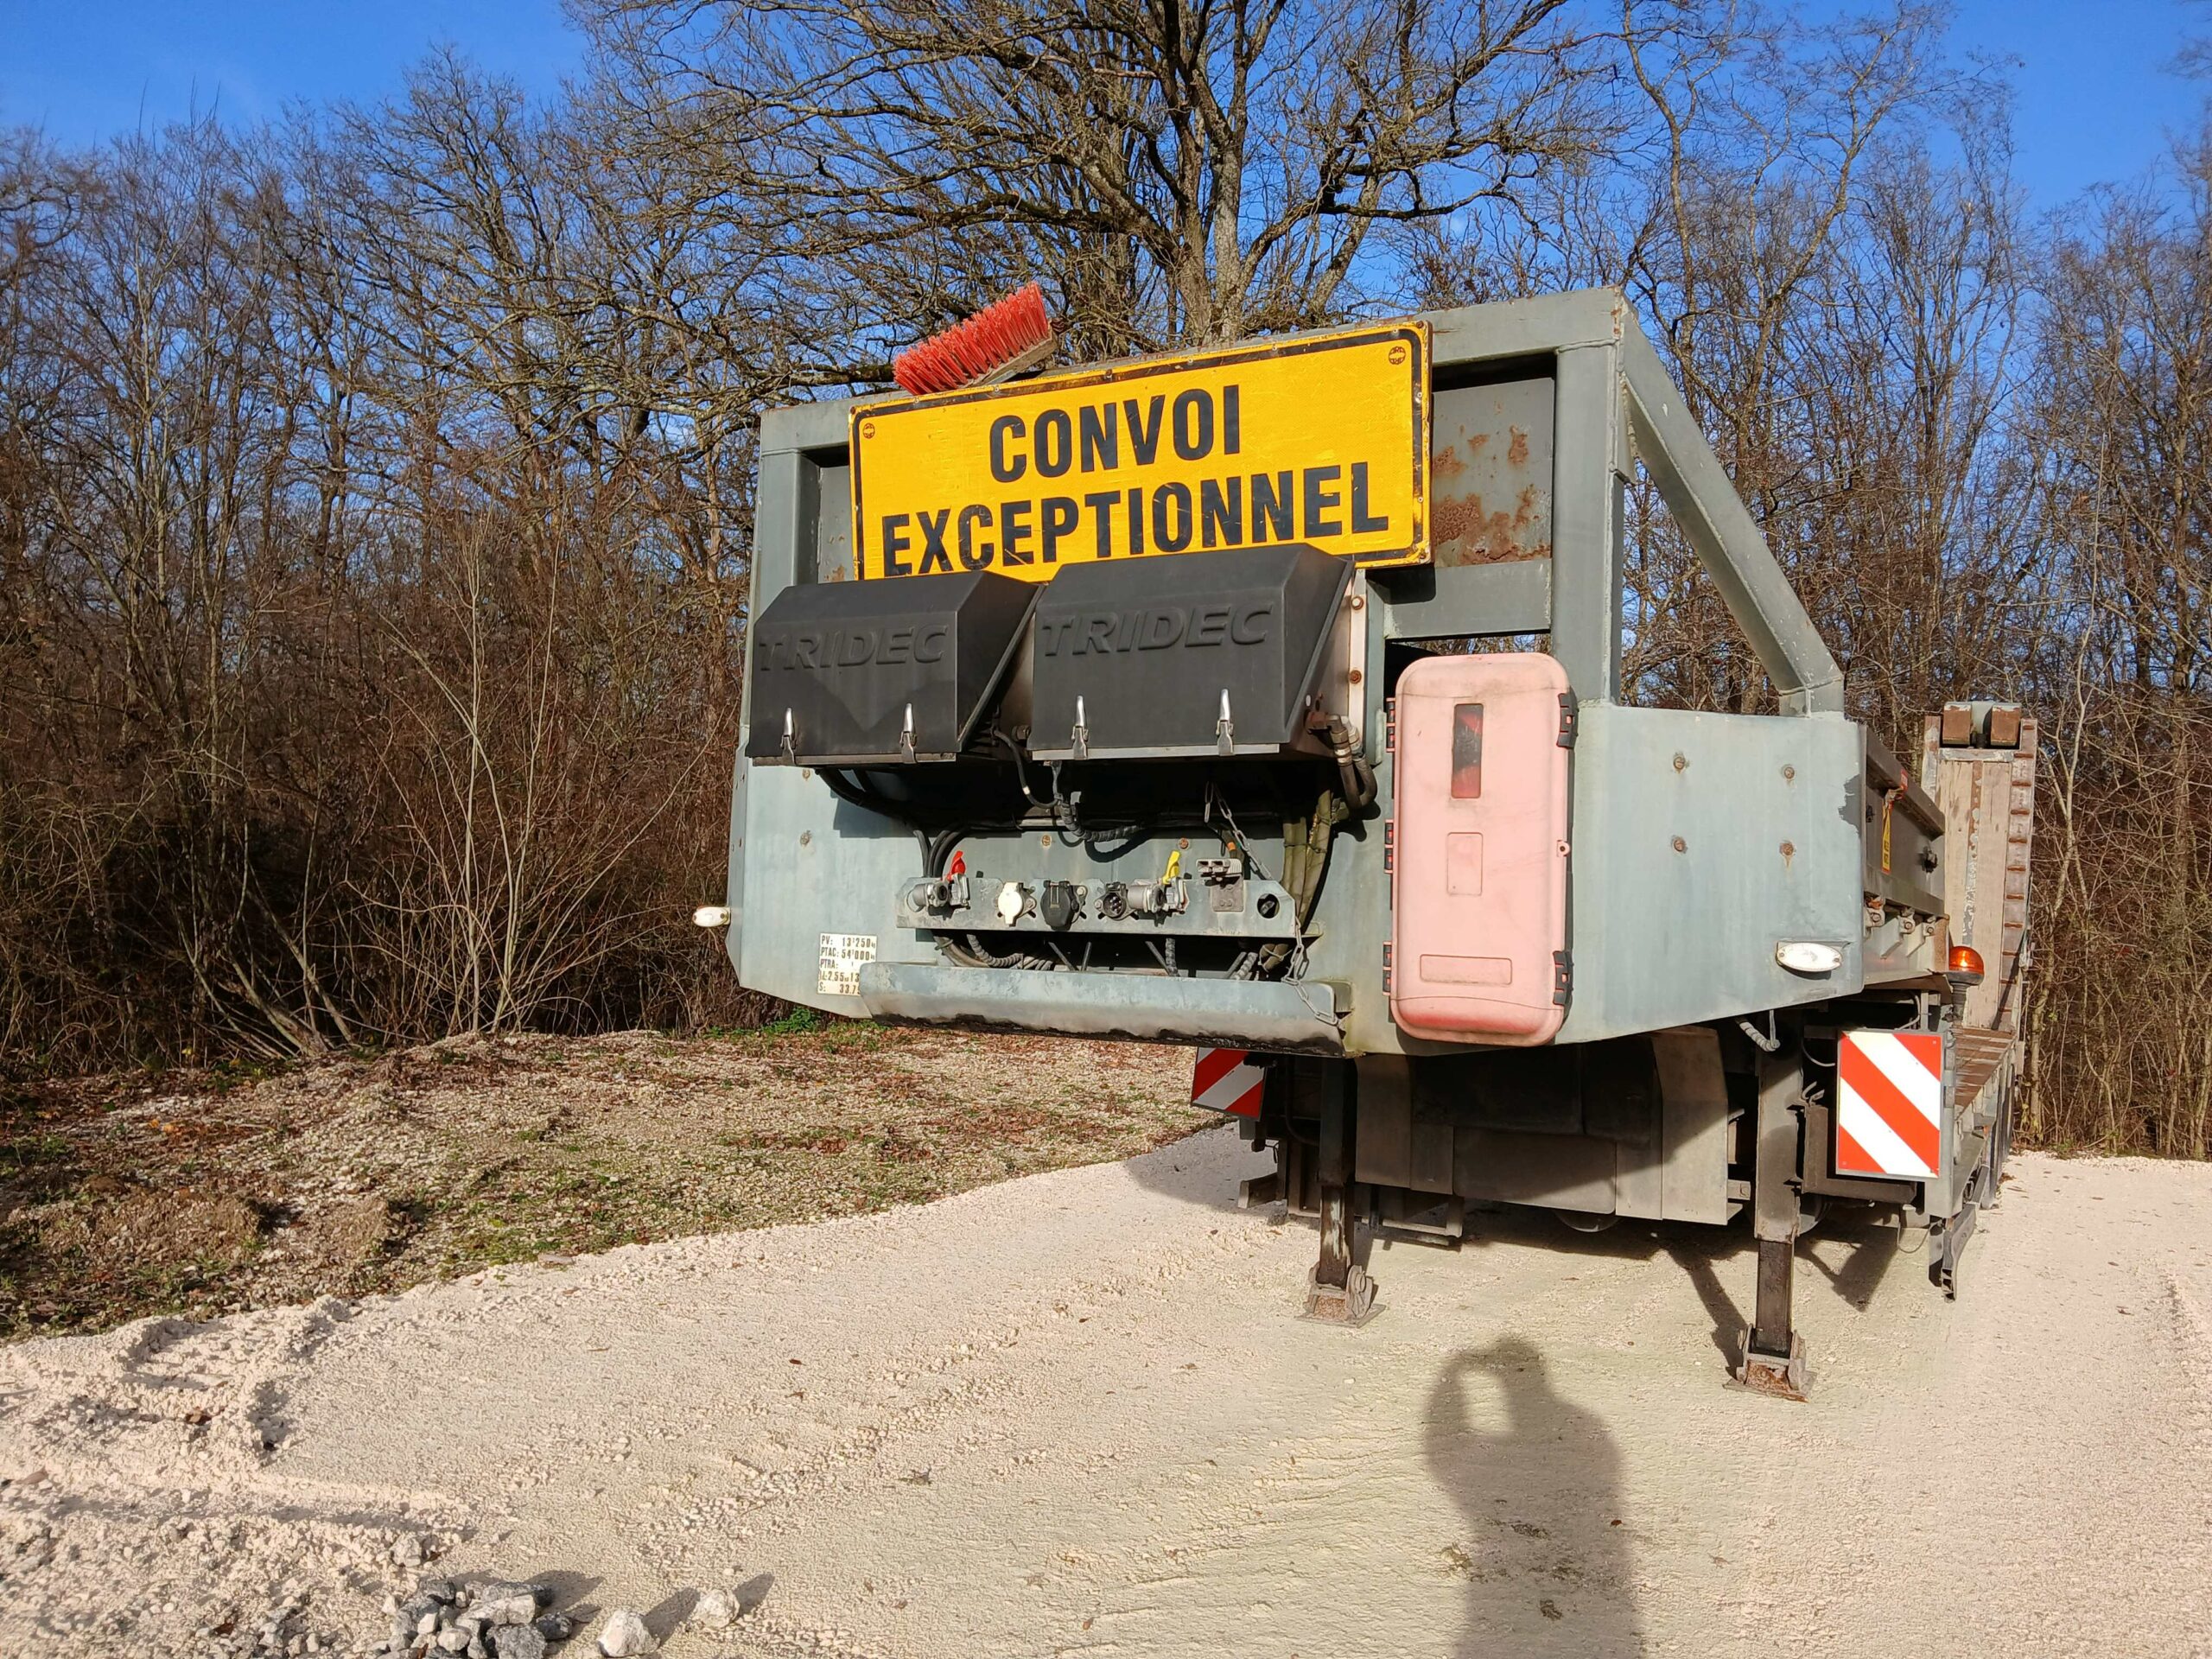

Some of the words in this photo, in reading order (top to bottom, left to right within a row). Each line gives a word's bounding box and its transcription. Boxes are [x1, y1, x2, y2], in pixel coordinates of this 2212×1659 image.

[989, 385, 1239, 482] CONVOI
[882, 461, 1389, 576] EXCEPTIONNEL
[759, 623, 948, 671] TRIDEC
[1041, 602, 1273, 657] TRIDEC
[820, 959, 838, 969] PTRA:
[821, 947, 839, 957] PTAC:
